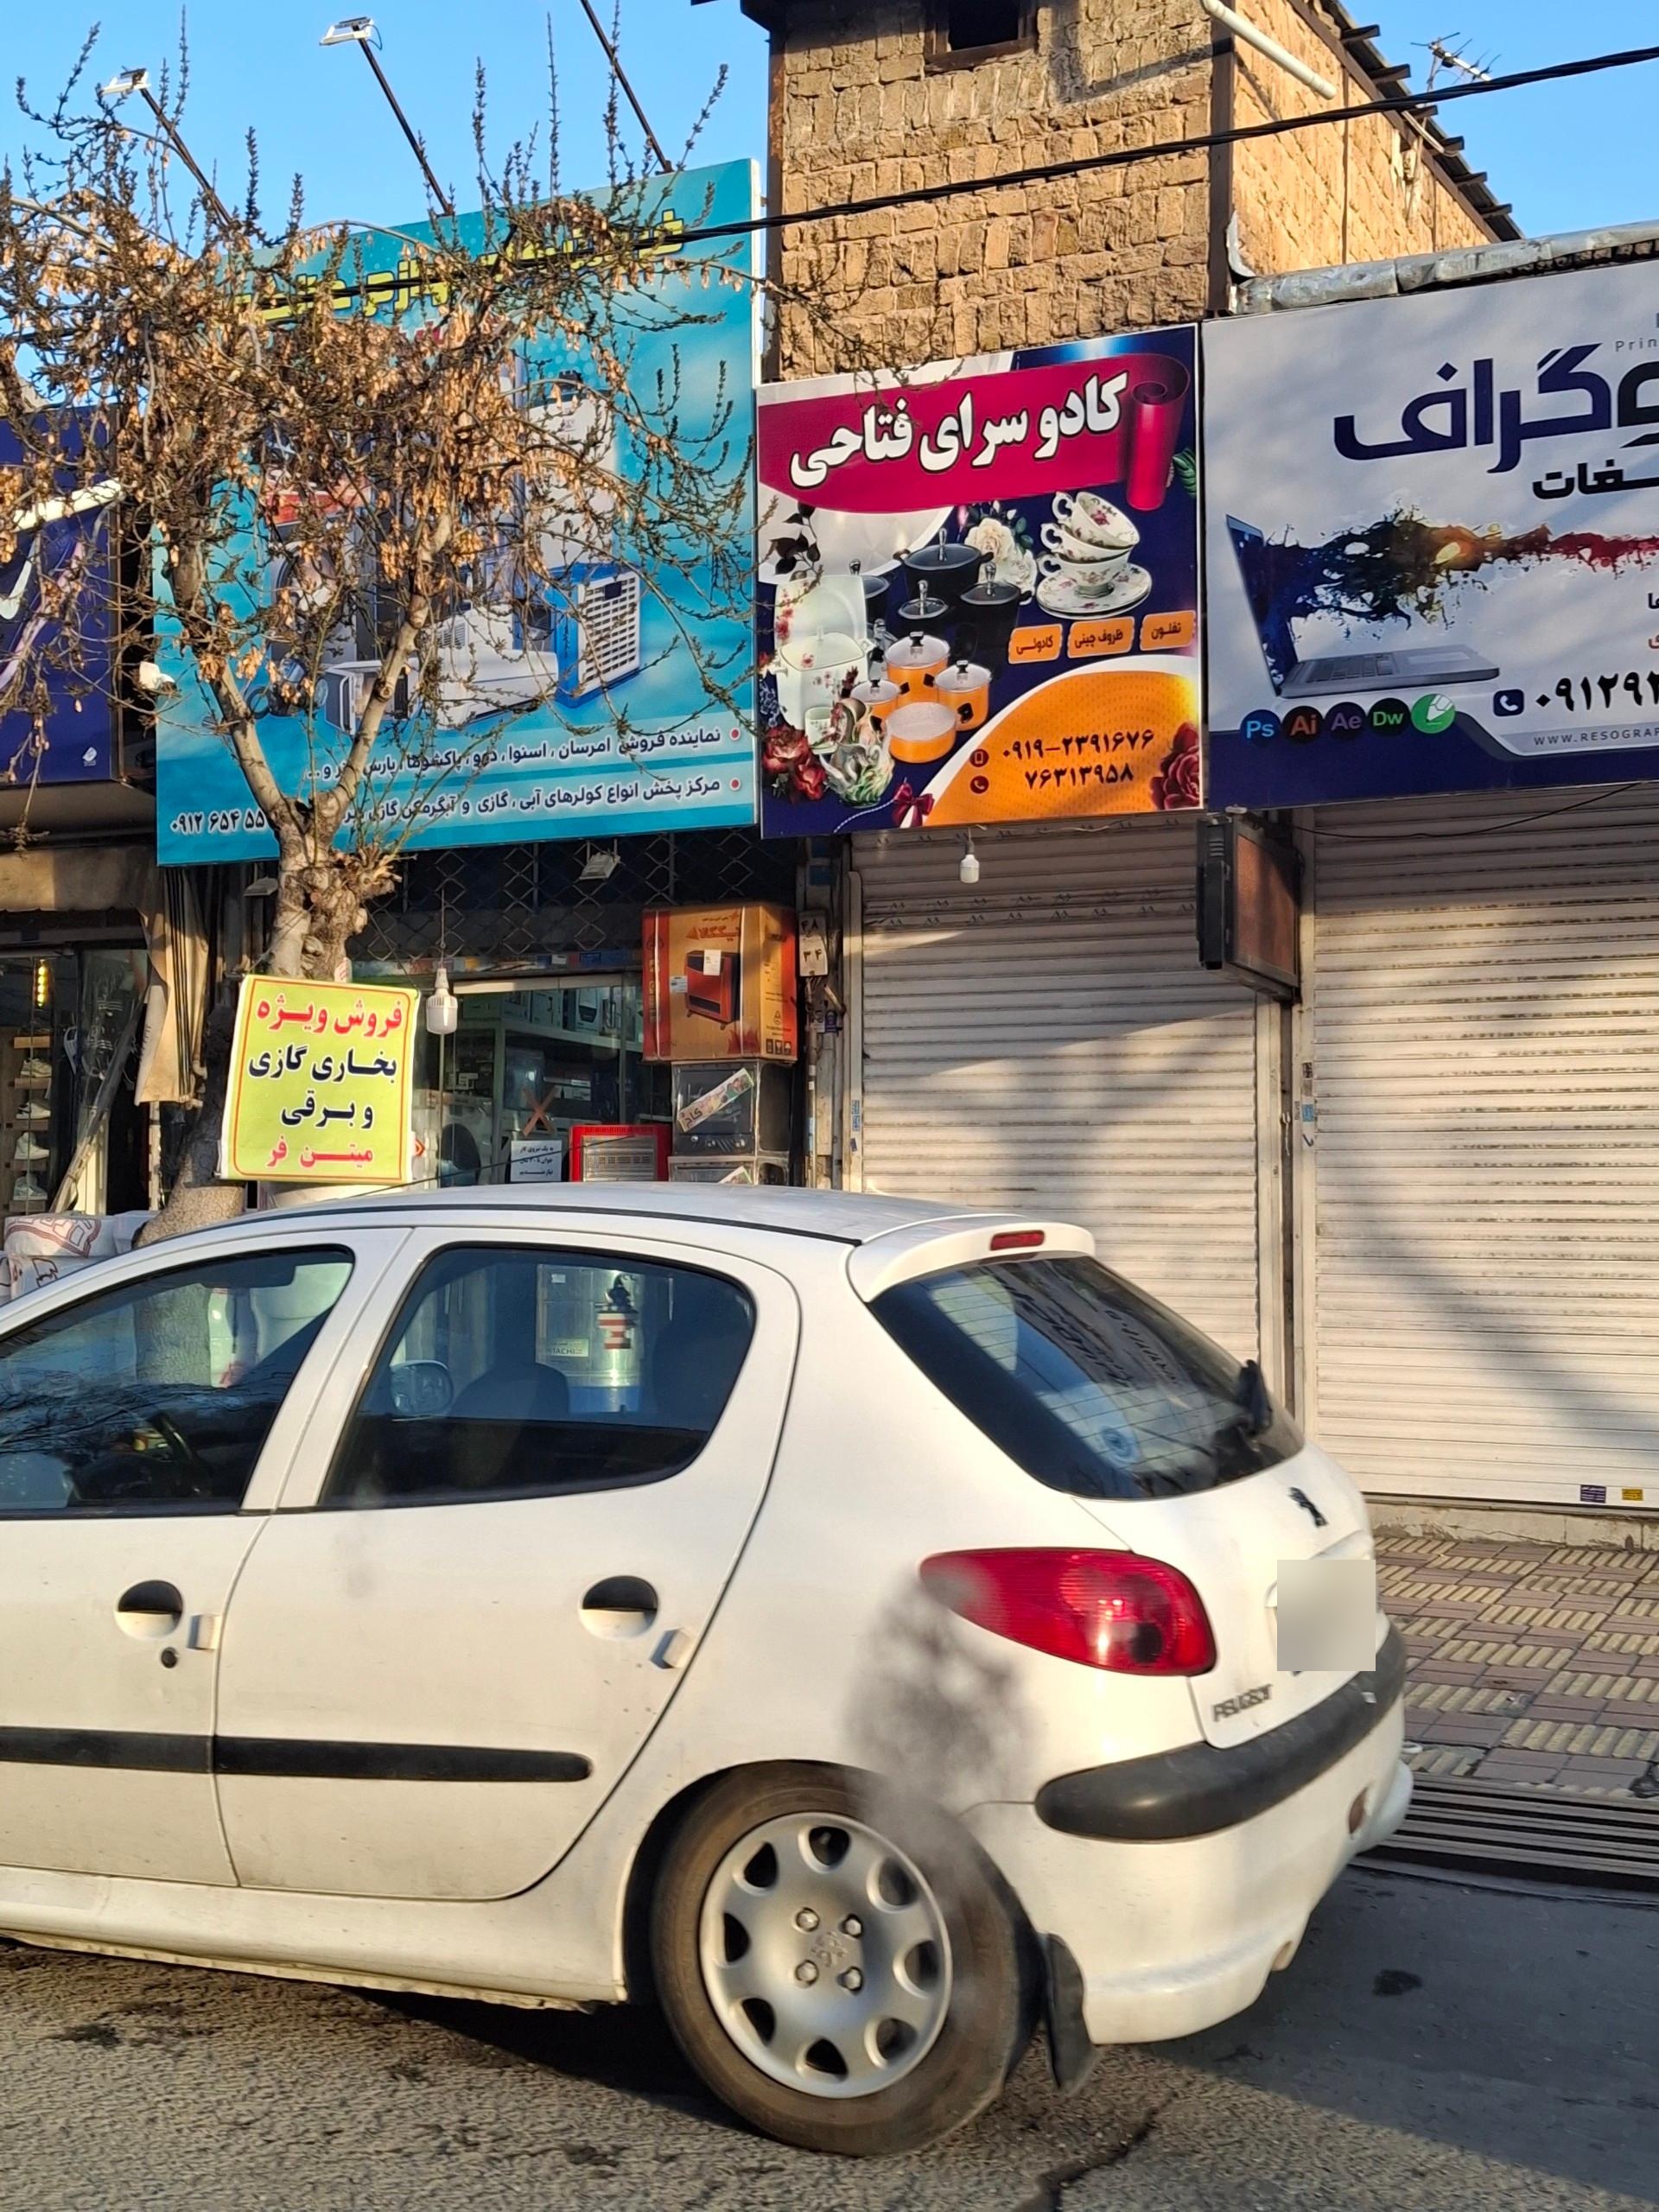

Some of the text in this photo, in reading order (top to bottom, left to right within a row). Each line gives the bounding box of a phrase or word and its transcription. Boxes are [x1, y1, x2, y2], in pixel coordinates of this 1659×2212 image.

[789, 371, 1128, 488] کادو سرای فتاحی
[1074, 628, 1124, 649] ظروف چینی
[1150, 621, 1182, 640] تفلون
[1246, 710, 1404, 739] Ps Ai Ae Dw
[618, 729, 665, 755] فروش
[669, 728, 721, 749] نماینده
[685, 776, 721, 797] مرکز
[1024, 762, 1135, 790] ۷۶۳۱۳۹۵۸
[477, 791, 509, 813] گازی
[544, 785, 603, 808] کولرهای
[607, 782, 639, 804] انواع
[642, 779, 682, 801] پخش
[171, 812, 203, 834] ۰۹۱۲
[209, 810, 241, 831] ۶۵۴
[257, 994, 403, 1038] فروش ویژه
[248, 1043, 397, 1084] بخاری گازی
[281, 1089, 355, 1128] برقی
[267, 1135, 288, 1166] فر
